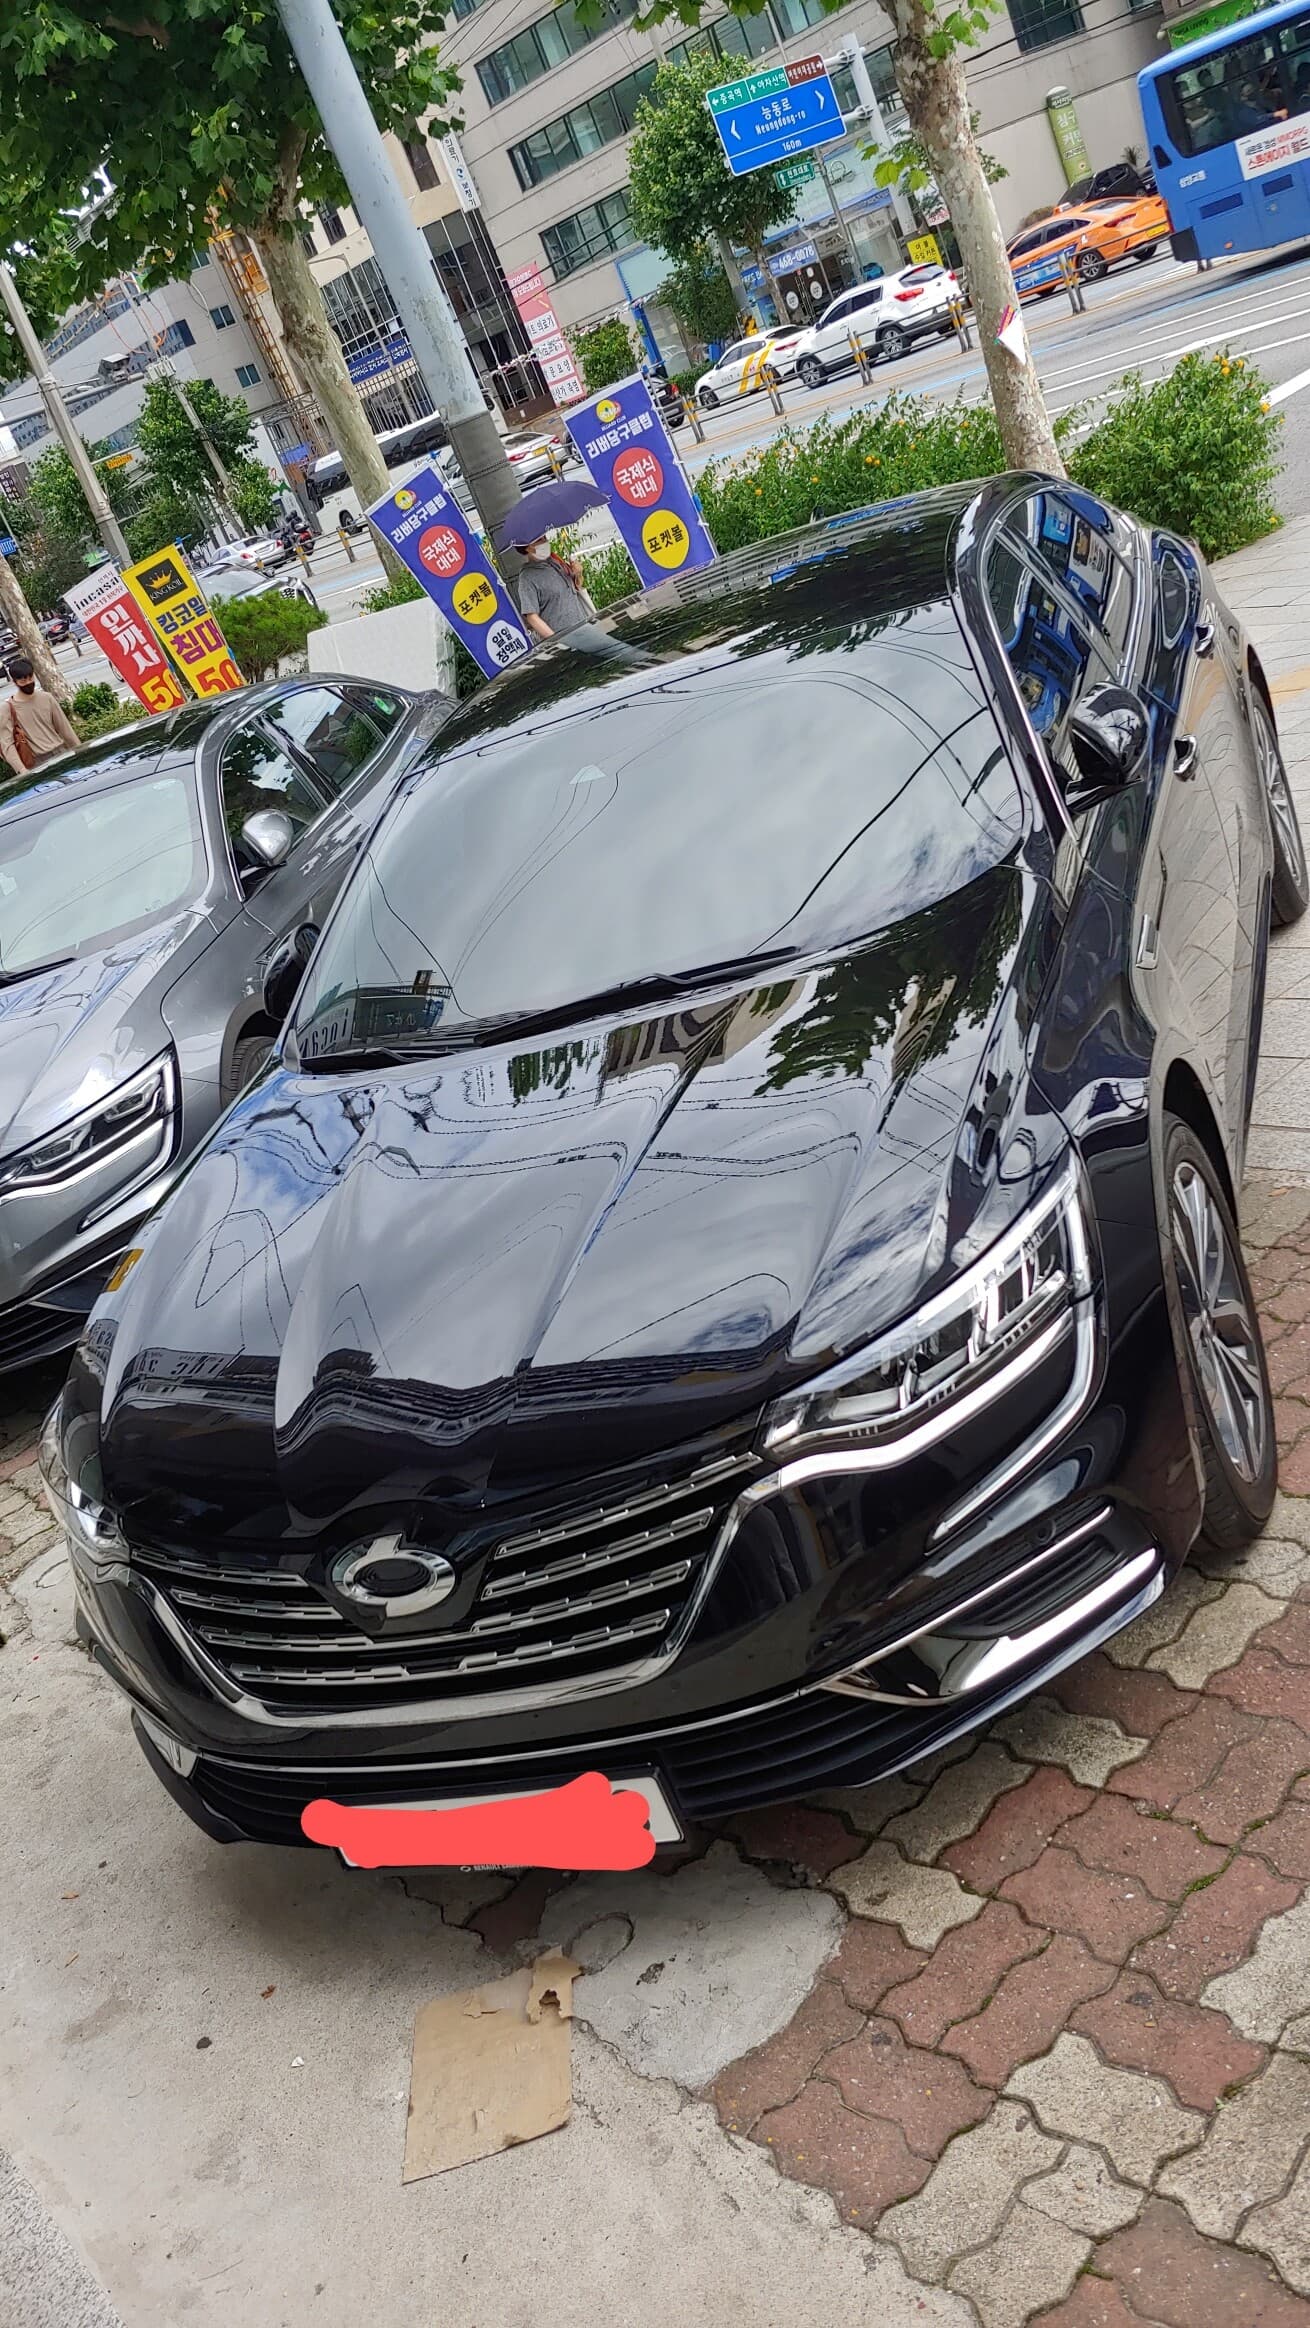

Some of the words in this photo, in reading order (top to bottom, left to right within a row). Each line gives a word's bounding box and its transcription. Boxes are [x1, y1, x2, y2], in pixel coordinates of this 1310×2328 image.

[757, 72, 787, 90] 아차산역
[788, 63, 817, 80] 어린이대공원
[719, 87, 743, 105] 중곡역
[761, 97, 792, 120] 능동로
[755, 110, 806, 136] Neungdong-ro
[782, 138, 802, 152] 160m
[584, 411, 655, 460] 리버당구클럽
[616, 455, 656, 486] 국제식
[629, 475, 658, 500] 대대
[390, 493, 448, 544] 리버당구클럽
[421, 530, 457, 562] 국제식
[648, 524, 684, 554] 포켓볼
[436, 549, 462, 572] 대대
[73, 575, 120, 612] incasa
[150, 586, 169, 602] KING
[458, 581, 494, 616] 포켓볼
[156, 594, 208, 635] 킹코일
[100, 603, 162, 676] 인까사
[170, 618, 226, 665] 침대
[491, 626, 513, 648] 일일
[495, 637, 527, 664] 정액제
[195, 658, 245, 697] 50
